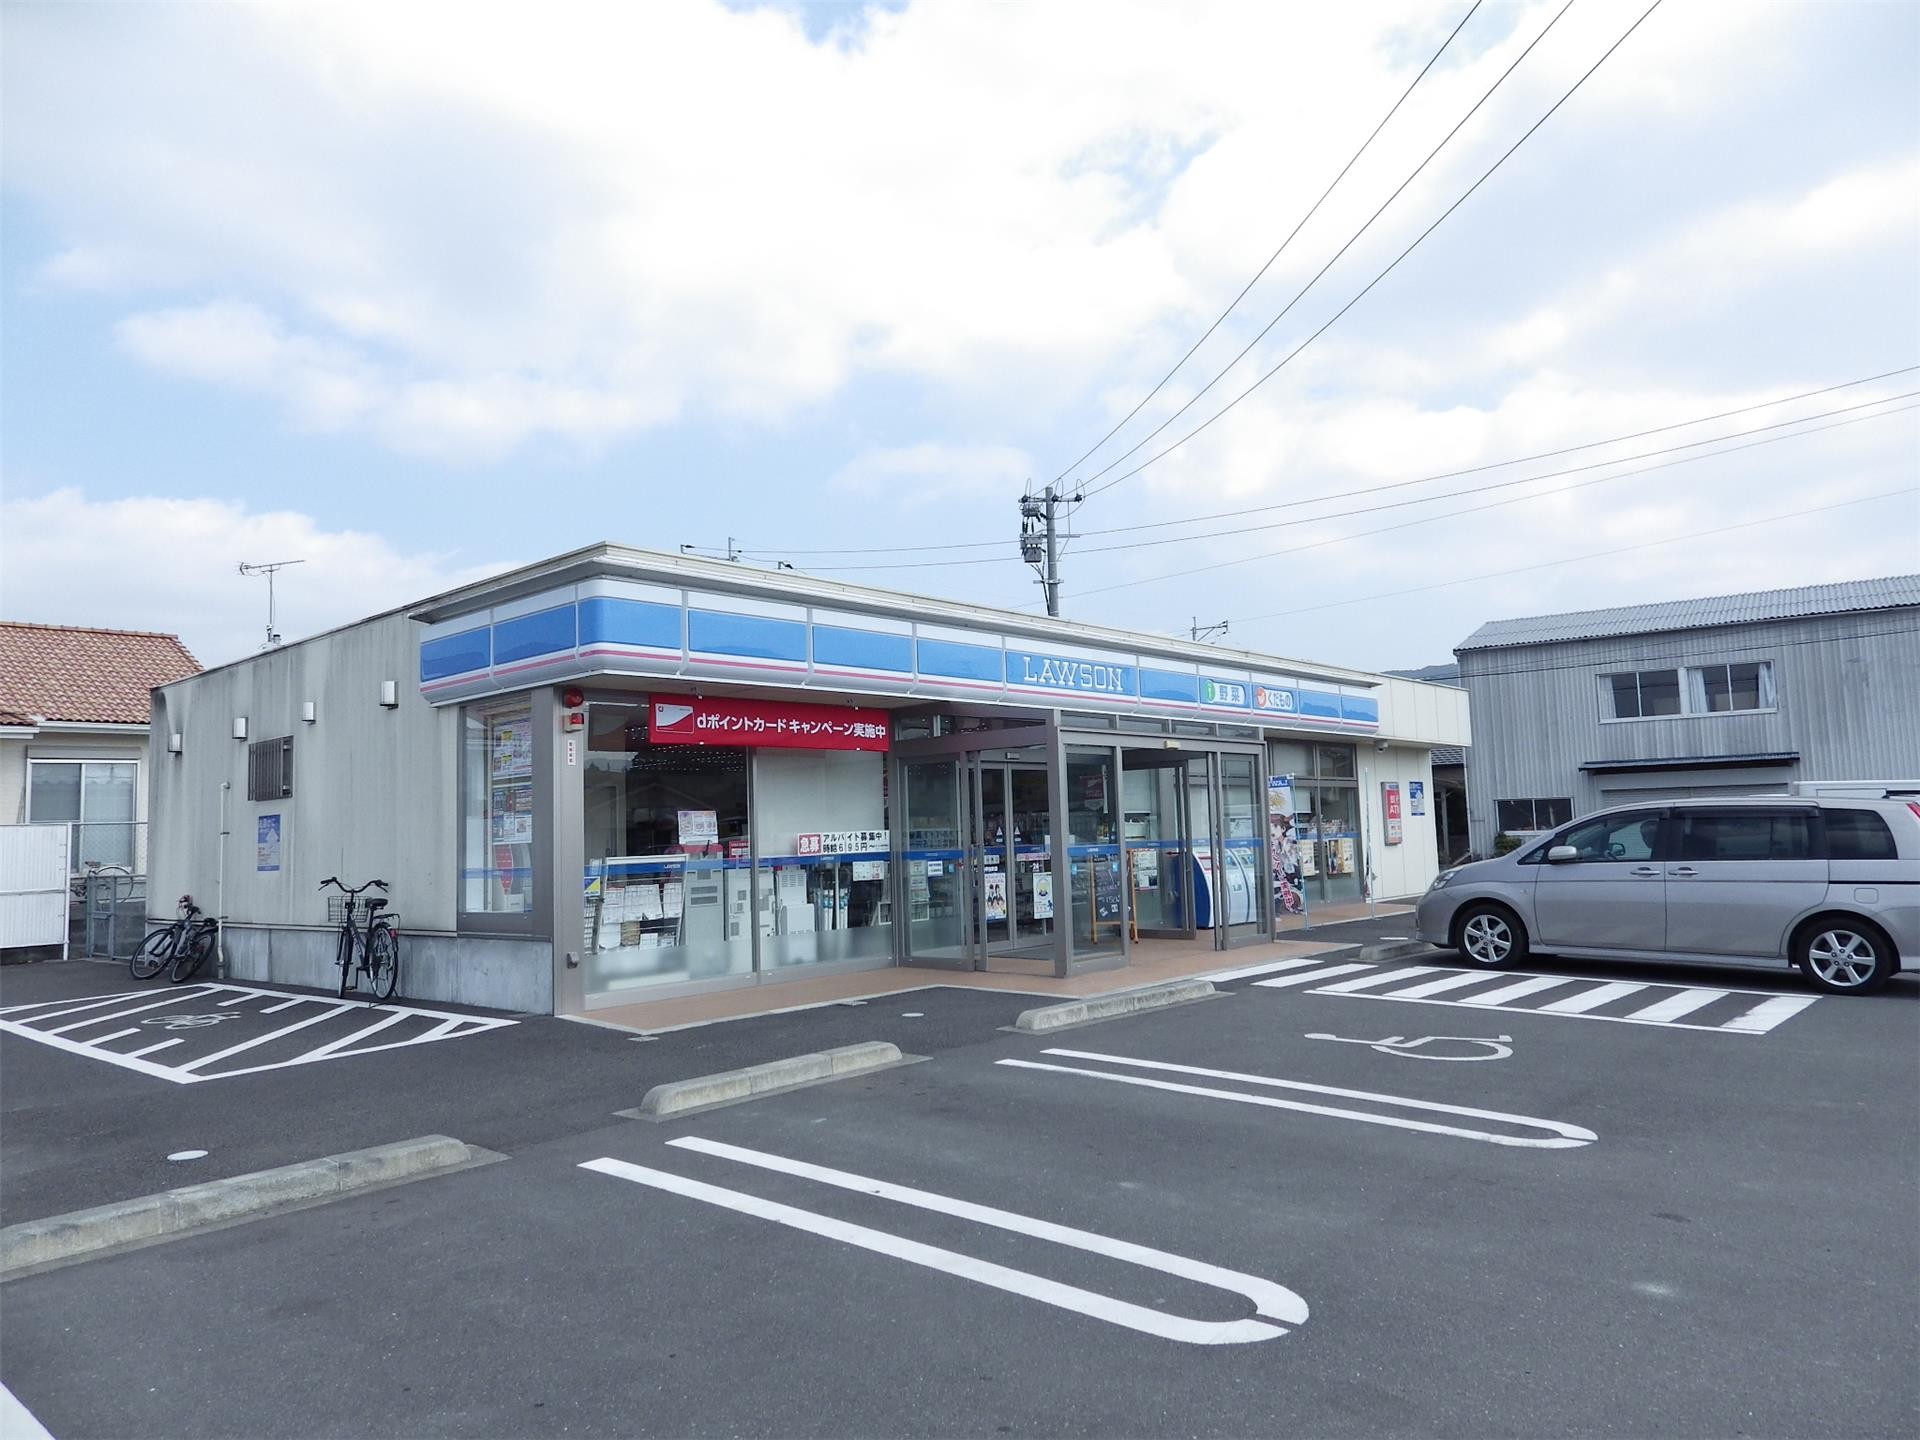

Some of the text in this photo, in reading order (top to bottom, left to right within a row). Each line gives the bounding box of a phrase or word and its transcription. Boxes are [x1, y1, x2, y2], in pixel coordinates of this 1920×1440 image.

[1023, 656, 1123, 691] LAWSON
[1219, 685, 1240, 703] 野菜
[1268, 692, 1291, 708] くだもの
[696, 713, 886, 739] dポイントカード キャンペーン実施中
[800, 836, 820, 853] 急募
